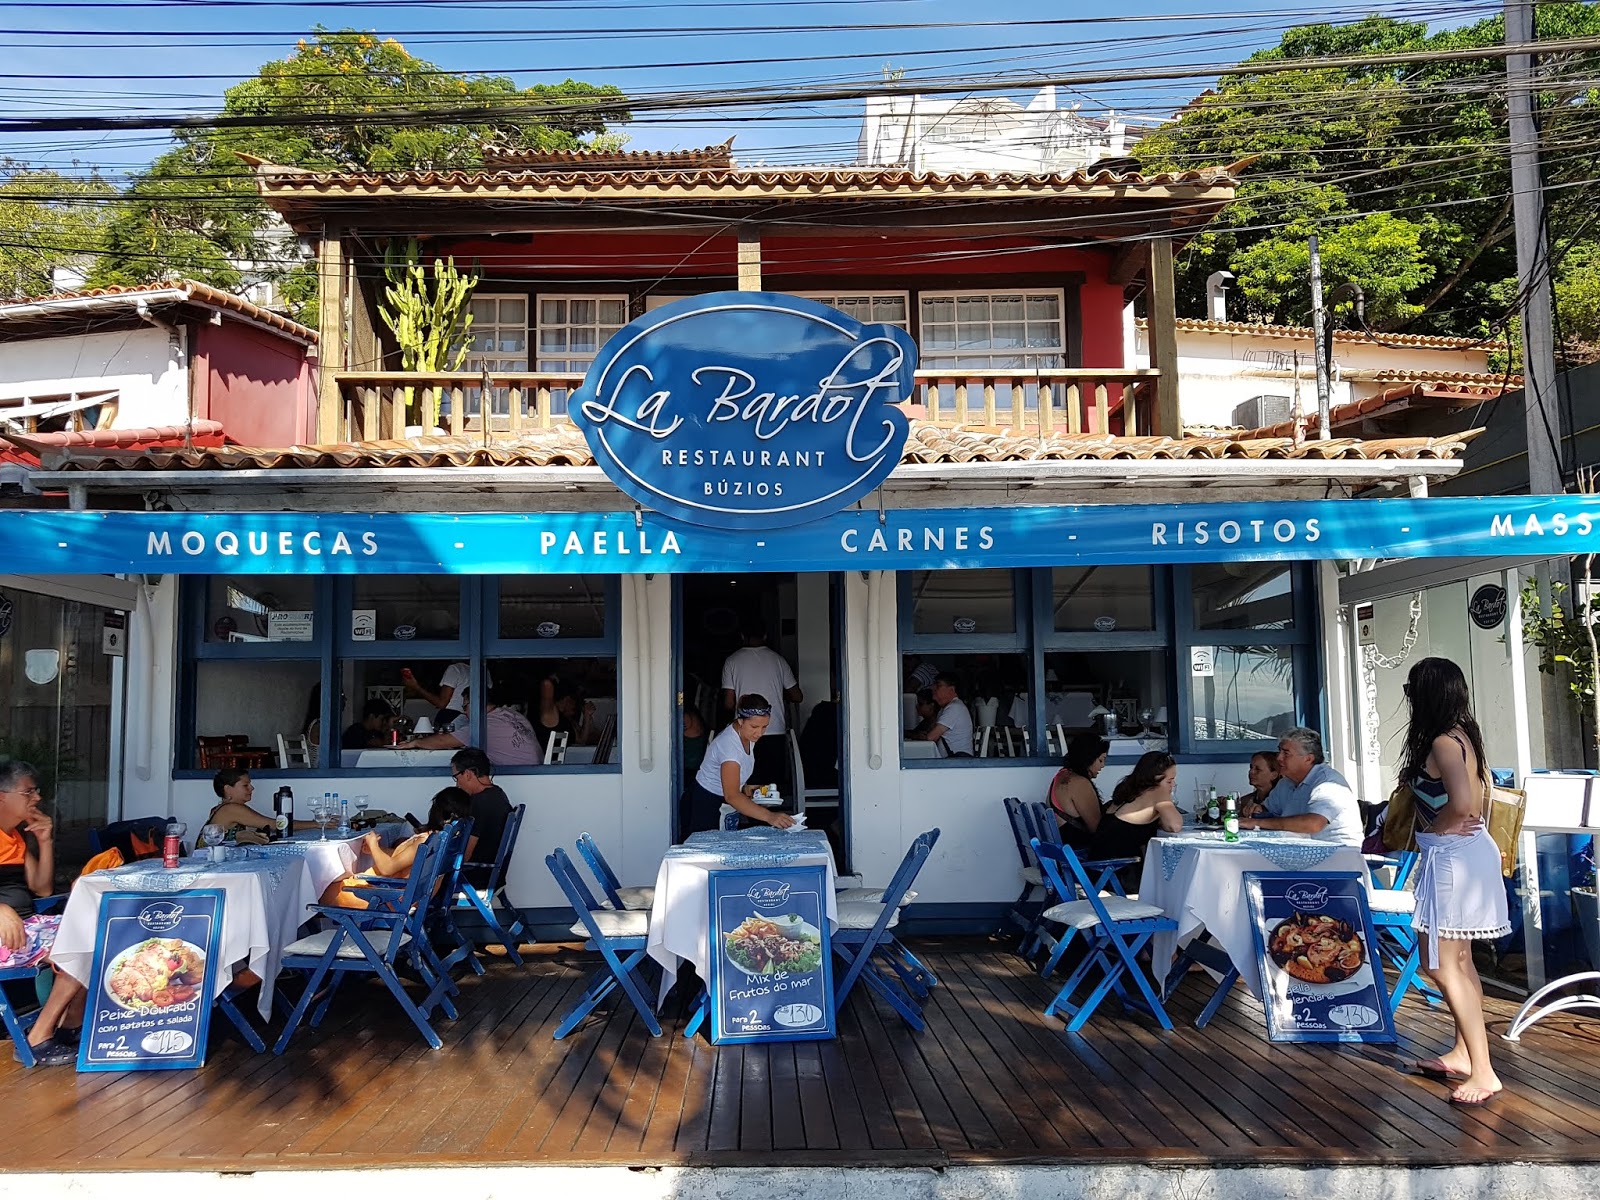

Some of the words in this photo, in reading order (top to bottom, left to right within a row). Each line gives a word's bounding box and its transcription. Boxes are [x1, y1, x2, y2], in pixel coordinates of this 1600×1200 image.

[582, 364, 684, 439] La
[691, 337, 904, 462] Bardot
[661, 450, 826, 468] RESTAURANT
[704, 478, 784, 496] BÚZIOS
[146, 531, 379, 556] MOQUECAS
[540, 530, 682, 555] PAELLA
[840, 526, 995, 553] CARNES
[1151, 518, 1321, 546] RISOTOS
[1489, 512, 1593, 538] MASS
[746, 974, 771, 986] Mix
[773, 970, 790, 981] de
[729, 986, 771, 1001] Frutos
[773, 981, 788, 992] do
[790, 976, 814, 989] mar
[1287, 983, 1311, 995] aella
[99, 1008, 136, 1022] Peixe
[140, 1001, 196, 1017] Dourado
[749, 1009, 762, 1025] 2
[1302, 1007, 1317, 1022] 2
[157, 1018, 165, 1026] e
[166, 1015, 193, 1025] salada
[741, 1024, 771, 1032] pessoas
[115, 1035, 130, 1051] 2
